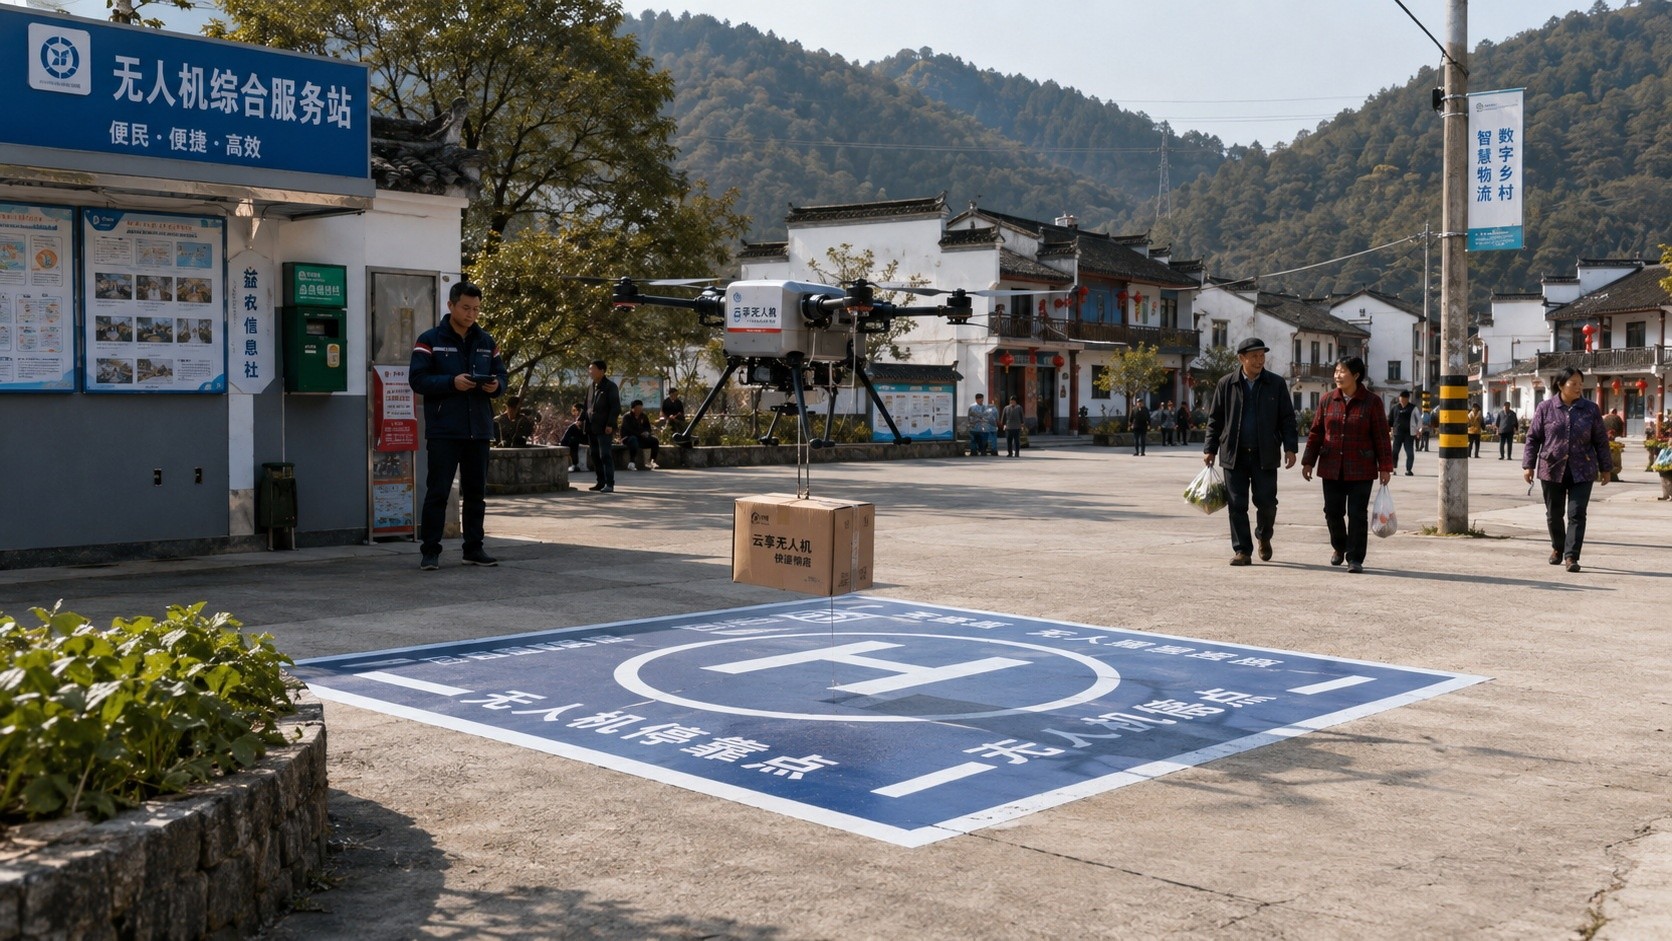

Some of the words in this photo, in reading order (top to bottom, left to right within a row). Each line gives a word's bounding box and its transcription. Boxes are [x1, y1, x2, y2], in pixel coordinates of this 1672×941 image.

[113, 54, 353, 130] 无人机综合服务站
[1477, 130, 1492, 202] 智慧物流
[1498, 127, 1514, 201] 数字乡村
[459, 690, 840, 780] 无人机停靠点
